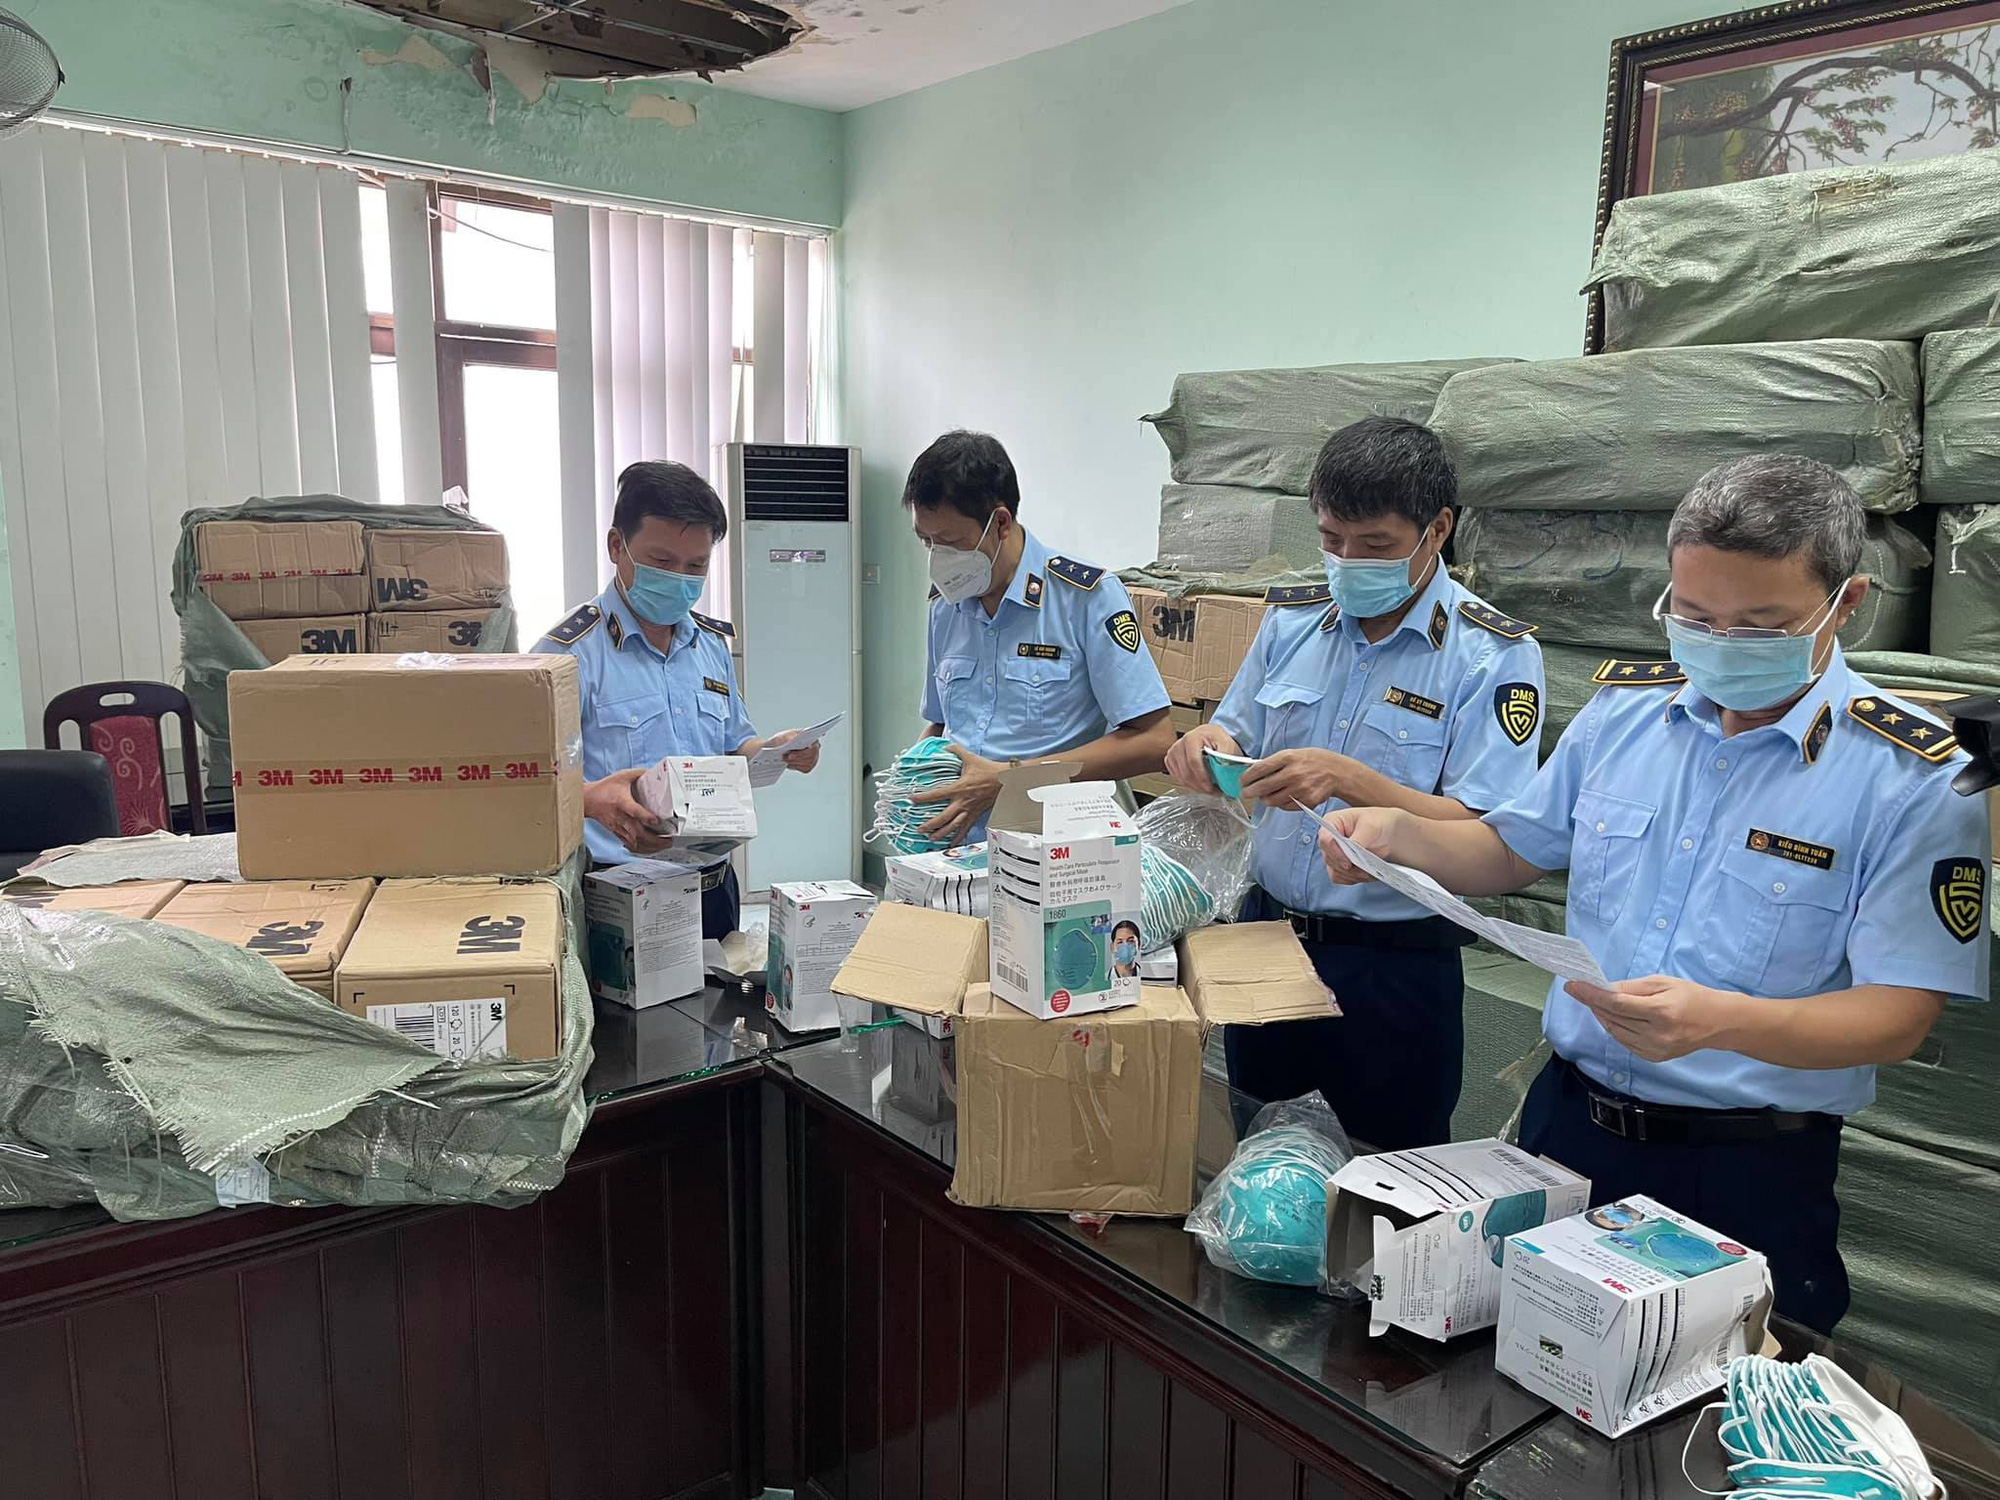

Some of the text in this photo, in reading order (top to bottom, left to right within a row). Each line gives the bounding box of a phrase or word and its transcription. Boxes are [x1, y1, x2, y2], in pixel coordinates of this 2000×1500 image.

[1113, 613, 1131, 625] DMS
[1152, 605, 1195, 642] 3M
[301, 629, 356, 653] 3M
[1511, 688, 1535, 703] DMS
[258, 770, 294, 786] 3M
[309, 769, 344, 785] 3M
[359, 768, 394, 784] 3M
[408, 766, 442, 782] 3M
[457, 764, 491, 781] 3M
[506, 762, 539, 779] 3M
[1050, 847, 1069, 860] 3M
[1049, 909, 1067, 919] 1860
[457, 915, 526, 954] 3M
[490, 1003, 502, 1021] 3M
[1602, 1277, 1633, 1294] 3M
[1576, 1406, 1593, 1422] 3M
